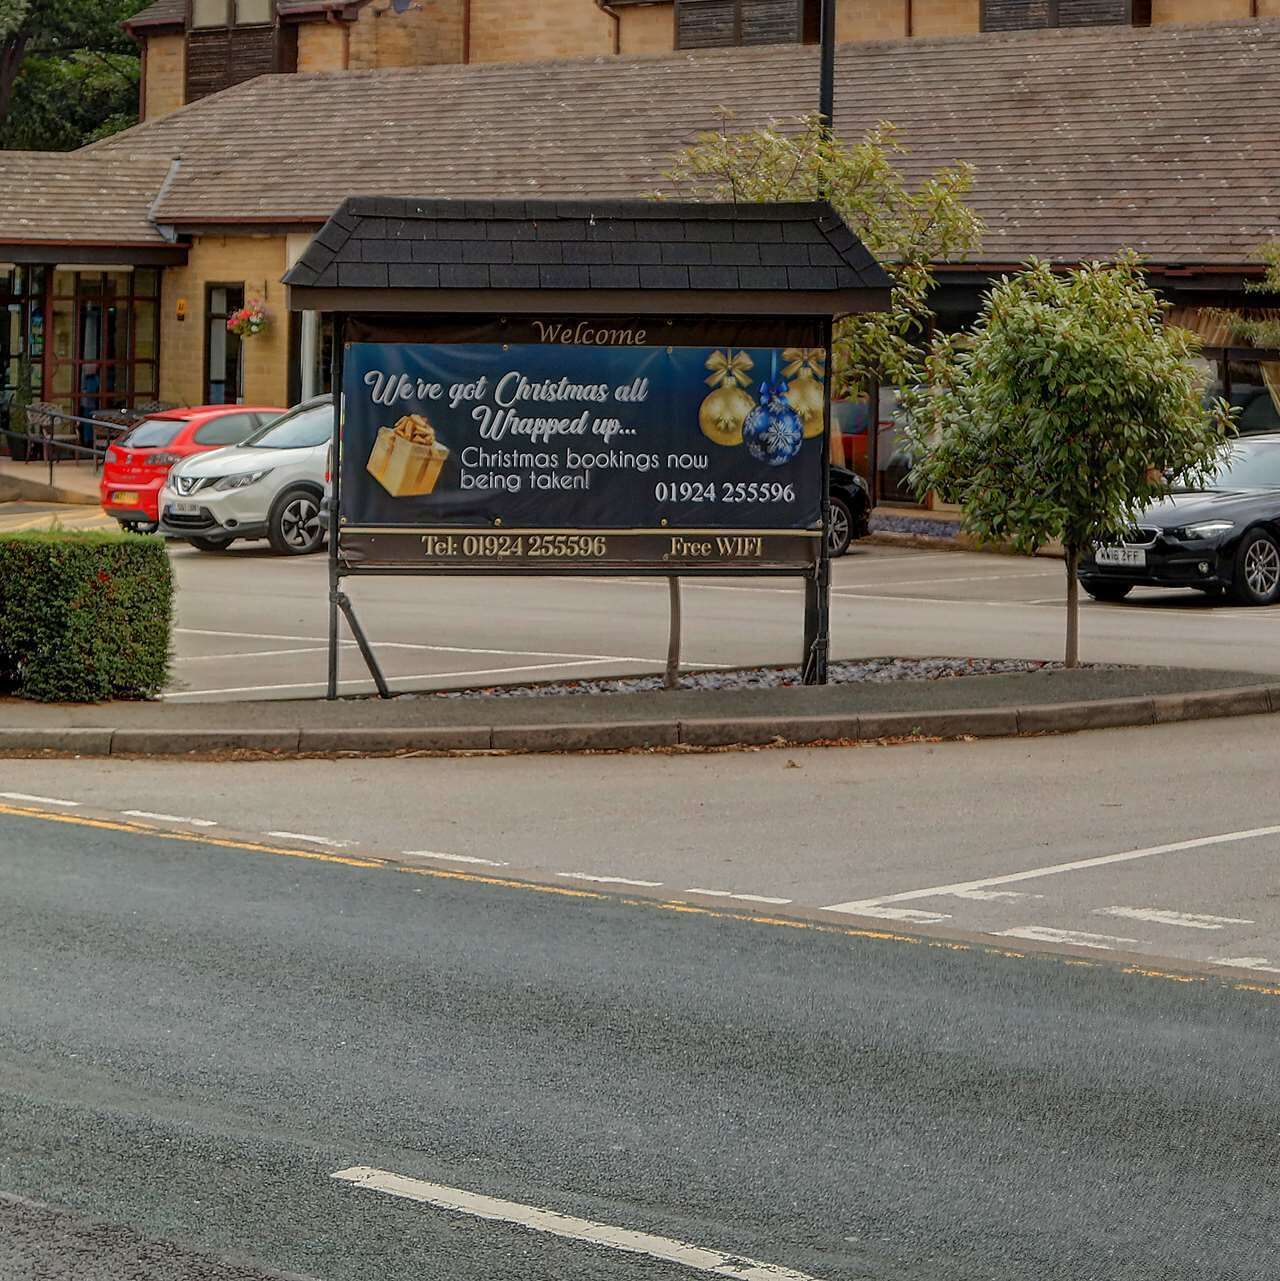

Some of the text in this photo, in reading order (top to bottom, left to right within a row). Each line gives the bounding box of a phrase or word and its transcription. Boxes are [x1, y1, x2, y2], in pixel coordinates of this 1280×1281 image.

[532, 321, 648, 345] Welcome
[363, 370, 650, 409] We've got Christmas all
[471, 405, 637, 445] Wrapped up...
[460, 446, 710, 472] Christmas bookings now
[459, 470, 591, 493] being taken!
[654, 481, 797, 504] 01924 255596
[421, 535, 607, 557] Tel: 01924 255596
[670, 537, 763, 557] Free WIFI
